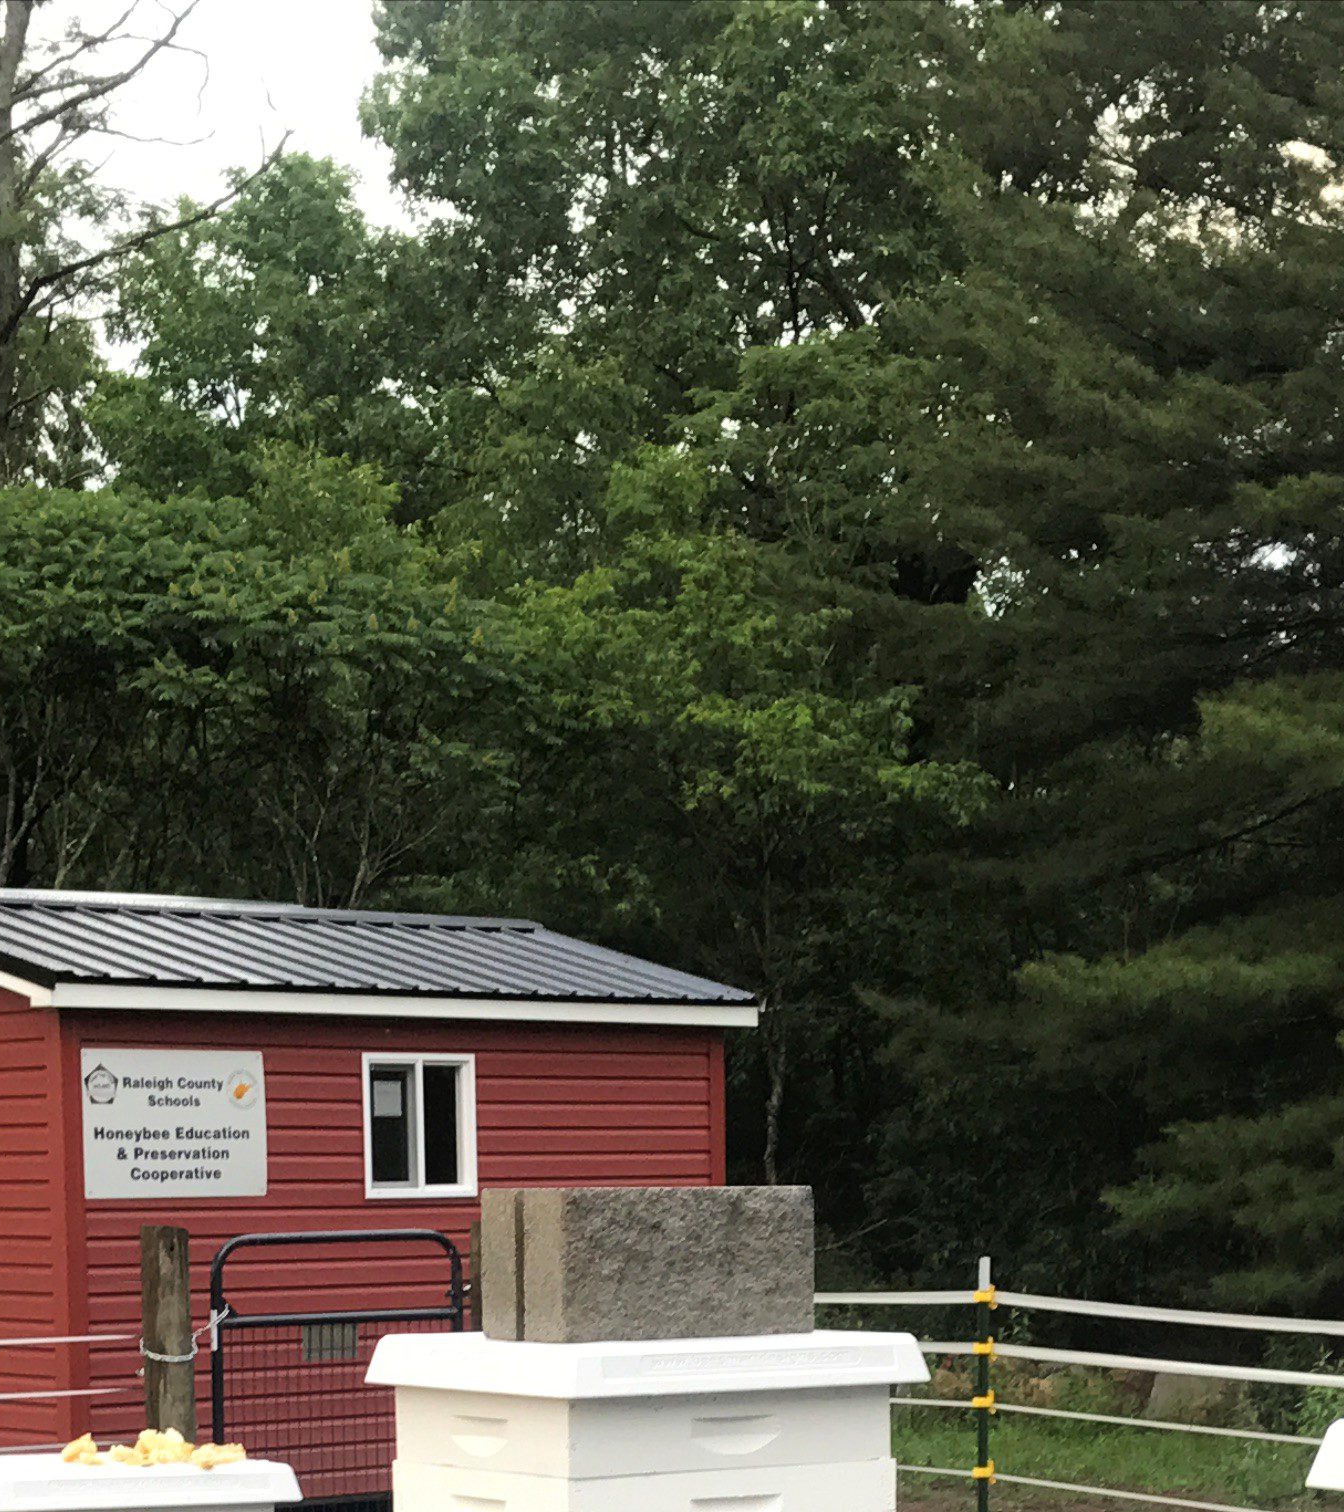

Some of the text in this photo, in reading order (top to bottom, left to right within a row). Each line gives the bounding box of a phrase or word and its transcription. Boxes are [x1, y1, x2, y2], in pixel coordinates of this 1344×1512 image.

[122, 1076, 173, 1091] Raleigh
[177, 1077, 223, 1092] County
[148, 1095, 201, 1107] Schools
[93, 1126, 250, 1142] Honeybee Education
[116, 1147, 230, 1160] & Preservation
[130, 1167, 222, 1182] Cooperative
